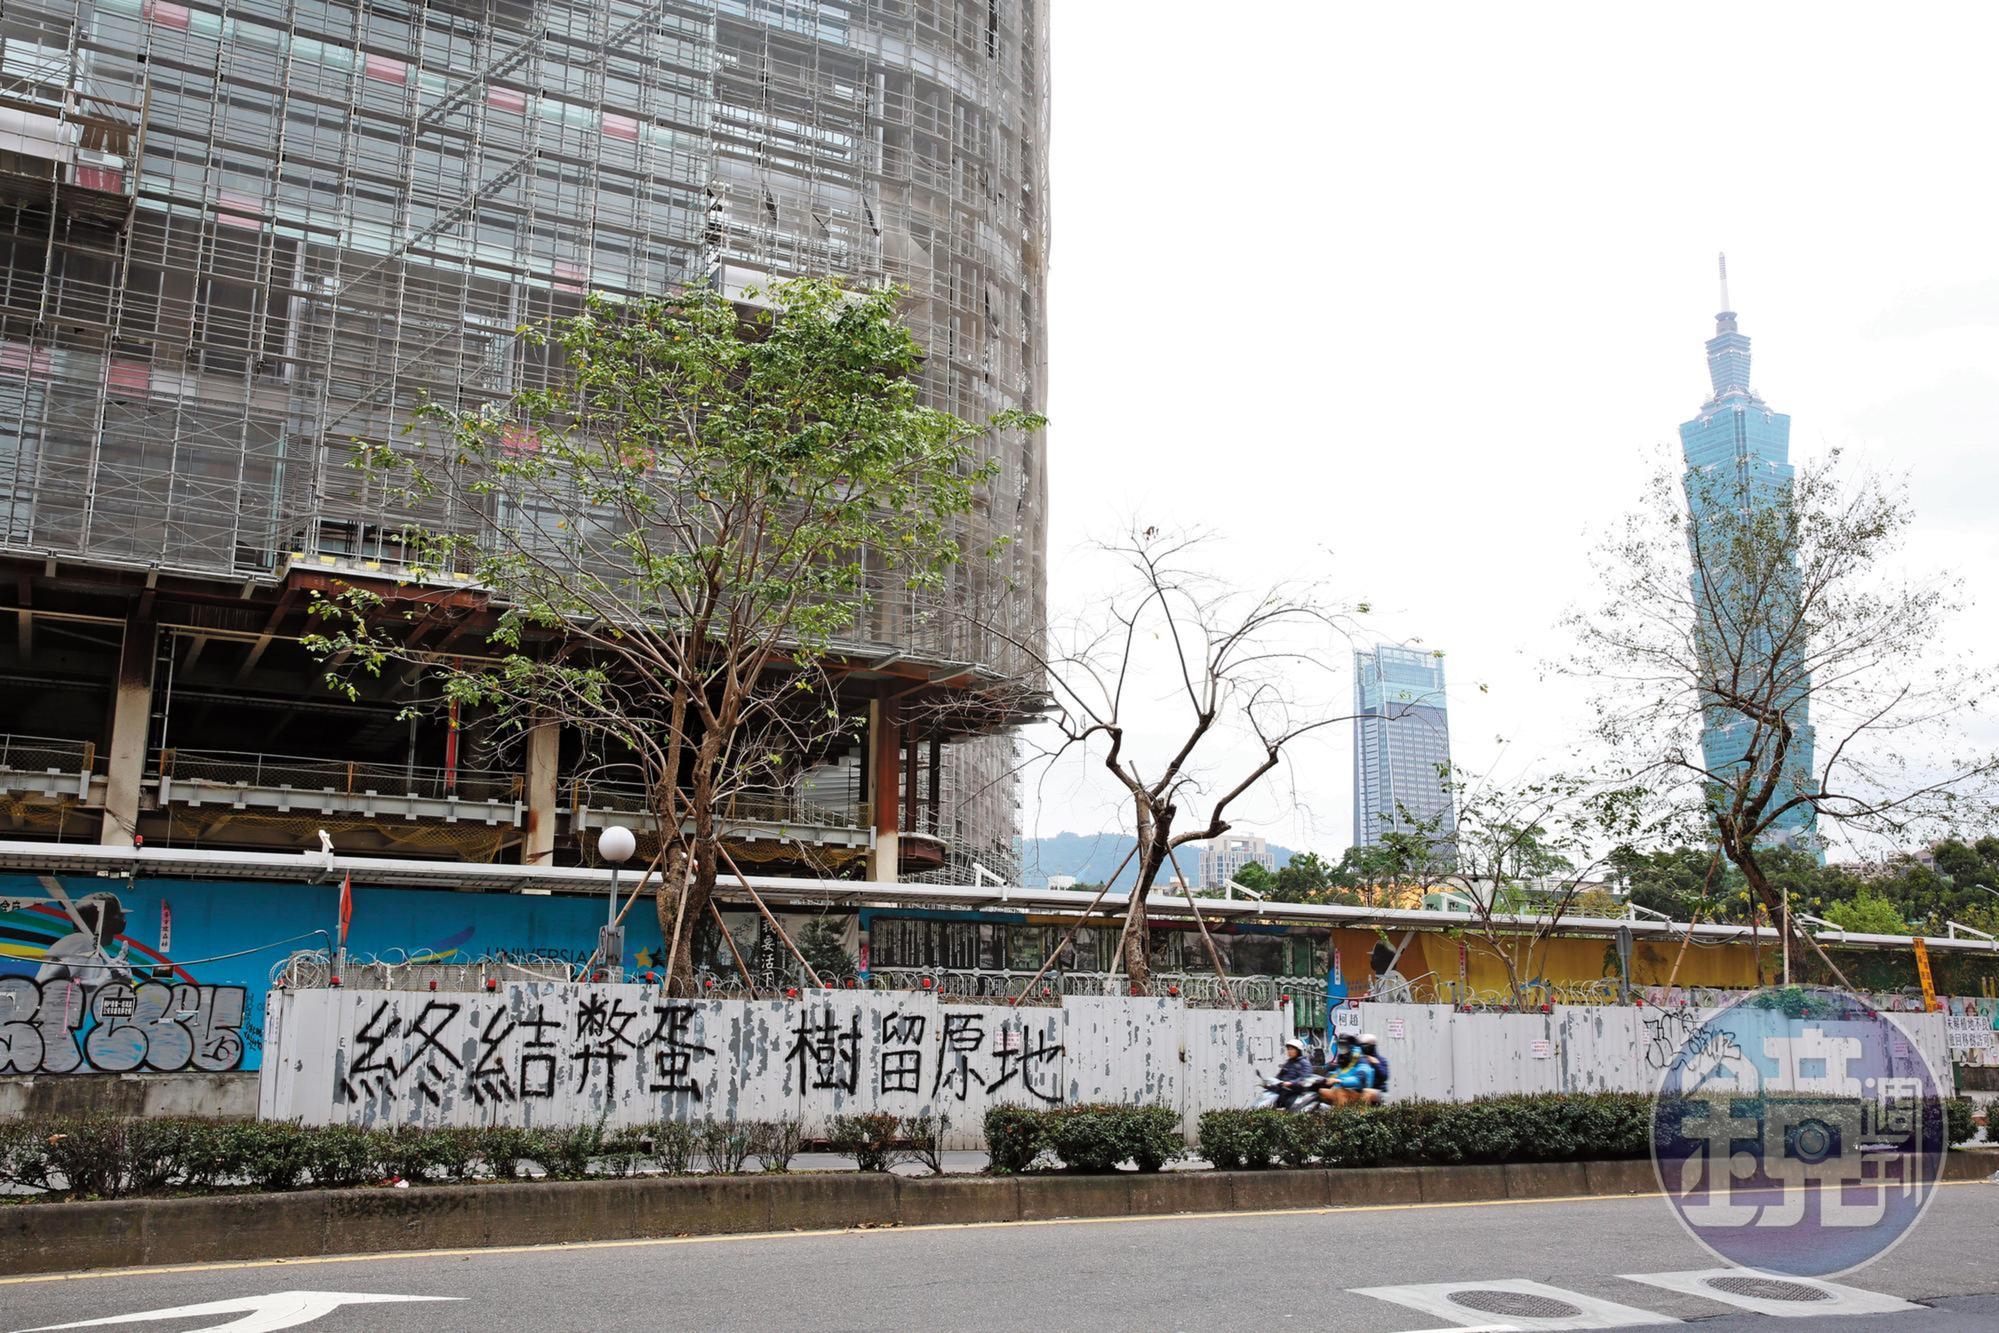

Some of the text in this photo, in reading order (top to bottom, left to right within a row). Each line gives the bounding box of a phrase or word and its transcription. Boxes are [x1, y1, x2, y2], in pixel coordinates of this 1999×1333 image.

[760, 917, 778, 993] 我要活下
[338, 993, 716, 1106] 終結弊蛋
[785, 1007, 1066, 1102] 樹留原地
